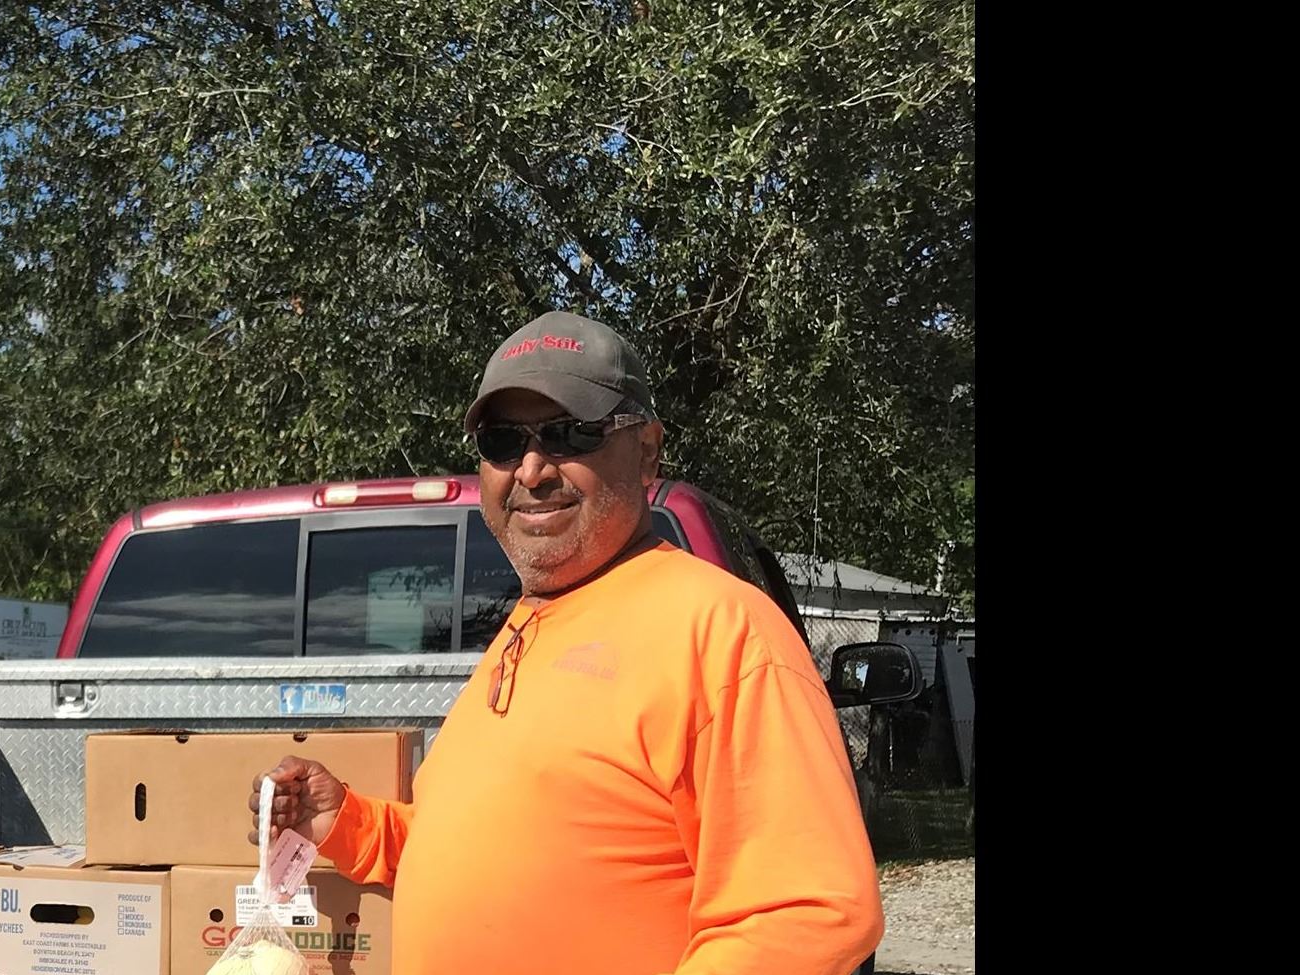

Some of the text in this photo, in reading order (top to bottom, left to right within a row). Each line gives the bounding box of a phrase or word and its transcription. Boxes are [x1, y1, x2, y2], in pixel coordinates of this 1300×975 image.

[0, 888, 21, 913] BU.
[117, 893, 151, 903] PRODUCE OF
[124, 905, 135, 913] USA
[124, 921, 152, 929] HONDURAS
[302, 917, 314, 926] 10
[124, 928, 146, 936] CANADA
[74, 942, 107, 950] VEGETABLES
